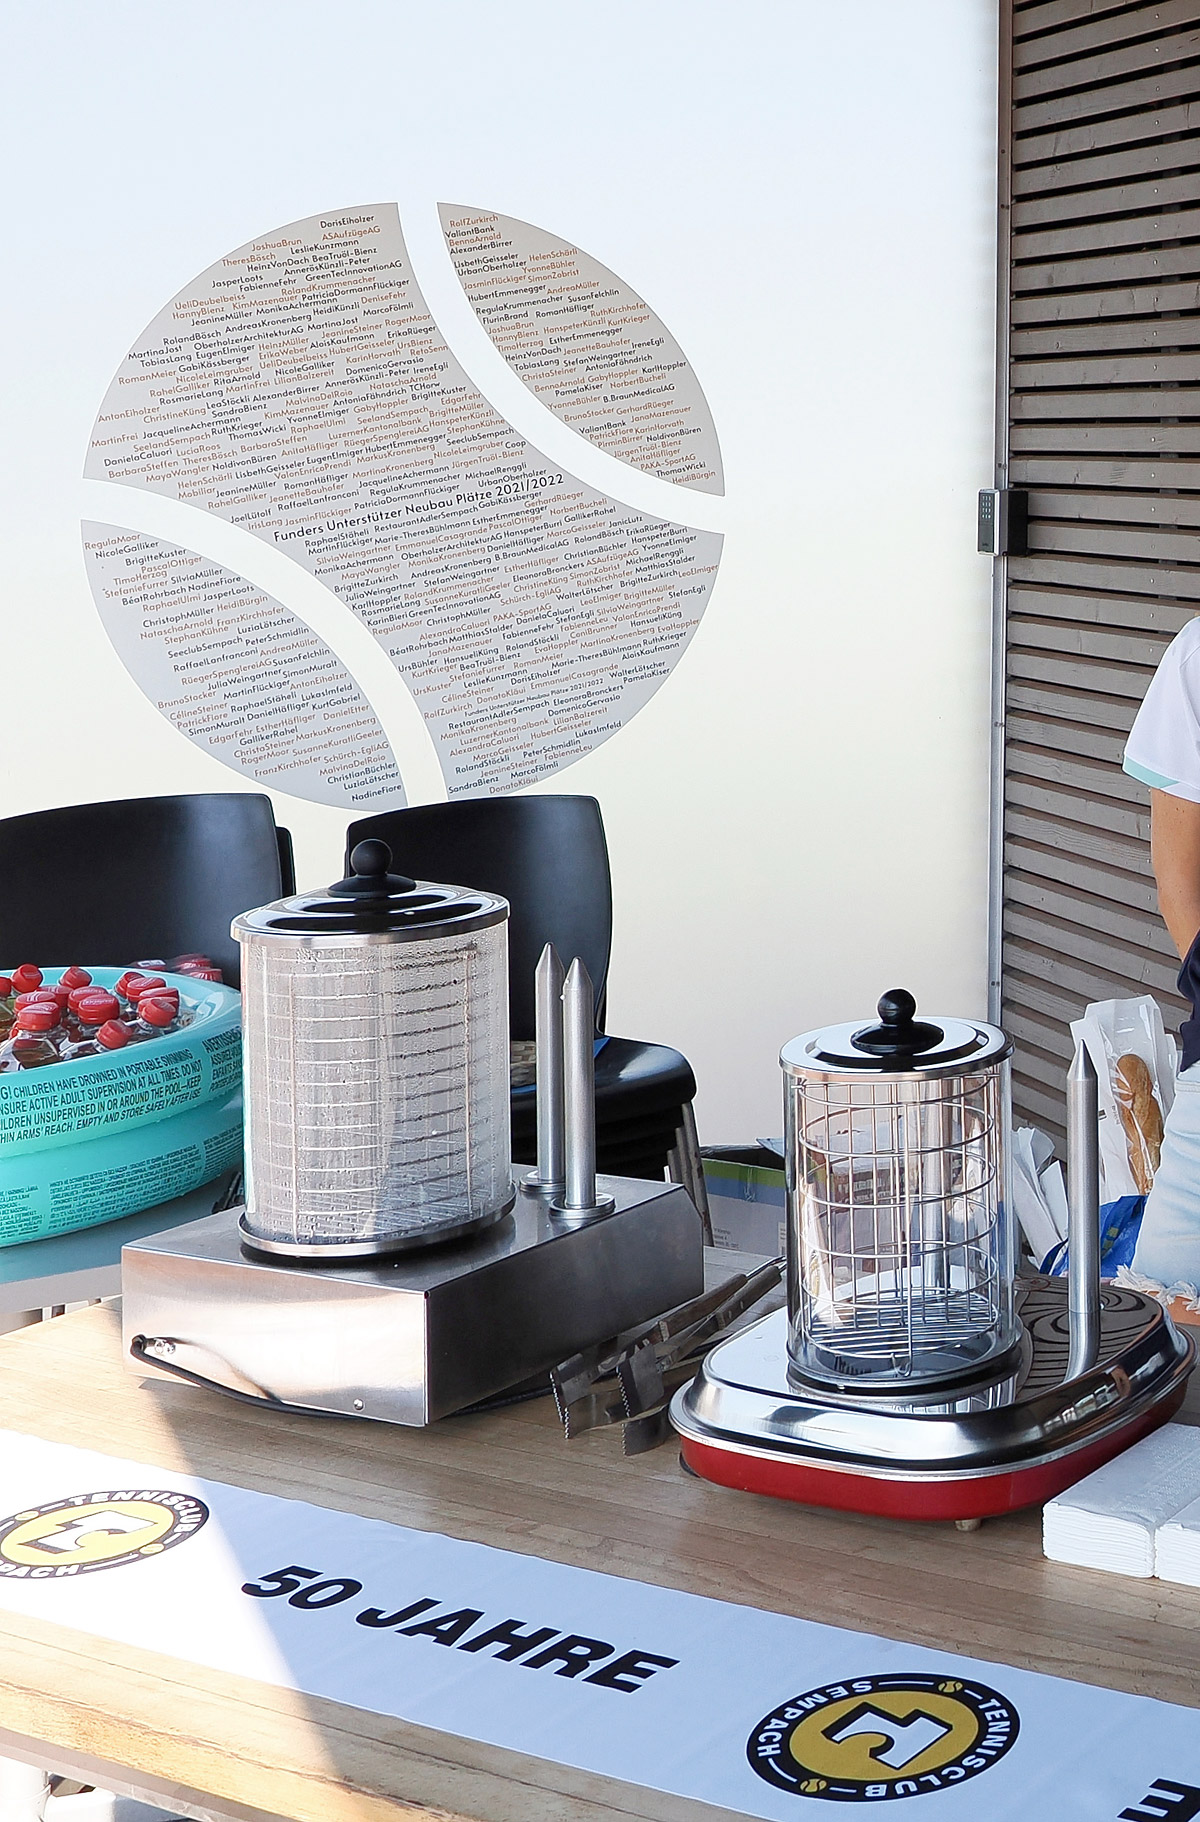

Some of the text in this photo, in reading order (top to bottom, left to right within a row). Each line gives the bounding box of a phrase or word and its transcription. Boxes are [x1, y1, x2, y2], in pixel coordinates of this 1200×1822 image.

[319, 212, 374, 229] DorisEiholzer
[444, 223, 494, 239] ValiantBank
[290, 236, 359, 254] LeslieKunzmann
[449, 237, 512, 255] AlexanderBirrer
[247, 255, 309, 272] HeinzVonDach
[453, 250, 518, 268] LisbethGeisseler
[457, 257, 527, 276] UrbanOberholzer
[211, 272, 263, 290] JasperLoots
[467, 281, 546, 304] HubertEmmenegger
[567, 286, 619, 303] SusanFelchlin
[255, 294, 337, 315] MonikaAchermann
[312, 300, 360, 315] HeidiKünzli
[362, 300, 413, 316] MarcoFölmli
[475, 292, 563, 317] RegulaKrummenacher
[535, 301, 594, 320] RomanHäfliger
[190, 308, 252, 326] JeanineMüller
[482, 309, 528, 324] FlurinBrand
[162, 328, 221, 346] RolandBösch
[309, 330, 374, 349] AloisKaufmann
[387, 322, 436, 340] ErikaRüeger
[548, 324, 623, 347] EstherEmmenegger
[127, 343, 182, 360] MartinaJost
[195, 341, 255, 361] EugenElmiger
[504, 344, 561, 362] HeinzVonDach
[631, 335, 664, 351] IreneEgli
[140, 351, 192, 370] TobiasLang
[178, 353, 250, 375] GabiKässberger
[274, 358, 334, 376] NicoleGalliker
[345, 354, 424, 375] DomenicoGervasio
[641, 358, 687, 376] KarlHoppler
[213, 370, 260, 386] RitaArnold
[408, 379, 440, 392] TCHorw
[159, 386, 223, 407] RosmarieLang
[332, 385, 406, 407] AntoniaFähndrich
[410, 383, 466, 403] BrigitteKuster
[554, 380, 603, 397] PamelaKiser
[211, 400, 267, 418] SandraBienz
[286, 405, 349, 426] YvonneElmiger
[211, 418, 263, 437] RuthKrieger
[364, 430, 446, 455] HubertEmmenegger
[504, 437, 526, 451] Coop
[103, 446, 172, 466] DanielaCaluori
[211, 451, 276, 471] NoldivonBüren
[306, 446, 363, 466] EugenElmiger
[464, 460, 527, 482] MichaelRenggli
[655, 459, 705, 477] ThomasWicki
[283, 470, 348, 492] RomanHäfliger
[273, 473, 564, 542] Funders Unterstützer Neubau Plätze 2021/2022
[277, 487, 359, 511] RaffaelLanfranconi
[229, 507, 271, 523] JoelLütolf
[563, 504, 616, 523] GallikerRahel
[625, 519, 671, 538] ErikaRüeger
[95, 538, 159, 559] NicoleGalliker
[125, 546, 187, 568] BrigitteKuster
[563, 539, 627, 560] ChristianBüchler
[625, 545, 684, 568] MichaelRenggli
[170, 566, 223, 584] SilviaMüller
[187, 573, 241, 592] NadineFiore
[334, 571, 398, 595] BrigitteZurkirch
[423, 563, 500, 589] StefanWeingartner
[344, 578, 416, 603] JuliaWeingartner
[555, 581, 613, 601] WalterLötscher
[668, 583, 706, 601] StefanEgli
[142, 605, 214, 630] ChristophMüller
[361, 596, 421, 619] RosmarieLang
[426, 604, 491, 628] ChristophMüller
[244, 624, 309, 646] PeterSchmidlin
[448, 621, 513, 643] MatthiasStalder
[167, 634, 243, 660] SeeclubSempach
[621, 639, 679, 660] AloisKaufmann
[282, 658, 337, 678] SimonMuralt
[462, 666, 527, 688] LeslieKunzmann
[623, 665, 670, 684] PamelaKiser
[300, 682, 353, 701] LukasImfeld
[311, 691, 361, 711] KurtGabriel
[246, 698, 310, 723] DanielHäfliger
[574, 719, 622, 738] LukasImfeld
[522, 736, 580, 758] PeterSchmidlin
[455, 753, 509, 774] RolandStöckli
[509, 759, 558, 779] MarcoFölmli
[351, 782, 401, 802] NadineFiore
[13, 1081, 55, 1098] CHILDREN
[56, 1077, 78, 1092] HAVE
[79, 1069, 118, 1087] DROWNED
[127, 1058, 163, 1076] PORTABLE
[0, 1100, 27, 1115] NSURE
[29, 1095, 59, 1111] ACTIVE
[60, 1090, 86, 1106] ADULT
[87, 1080, 136, 1102] SUPERVISION
[138, 1077, 146, 1090] AT
[146, 1073, 160, 1087] ALL
[0, 1114, 31, 1130] ILDREN
[34, 1104, 96, 1125] UNSUPERVISED
[97, 1100, 105, 1112] IN
[107, 1098, 118, 1111] OR
[119, 1090, 149, 1107] AROUND
[151, 1086, 166, 1100] THE
[44, 1122, 75, 1137] REACH.
[75, 1115, 105, 1131] EMPTY
[103, 1111, 119, 1124] AND
[120, 1105, 145, 1120] STORE
[68, 1490, 202, 1533] TENNISCLUB
[0, 1561, 80, 1578] PACH
[242, 1565, 680, 1693] 50 JAHRE
[757, 1679, 874, 1759] SEMPACH
[865, 1699, 1006, 1798] TENNISCLUB
